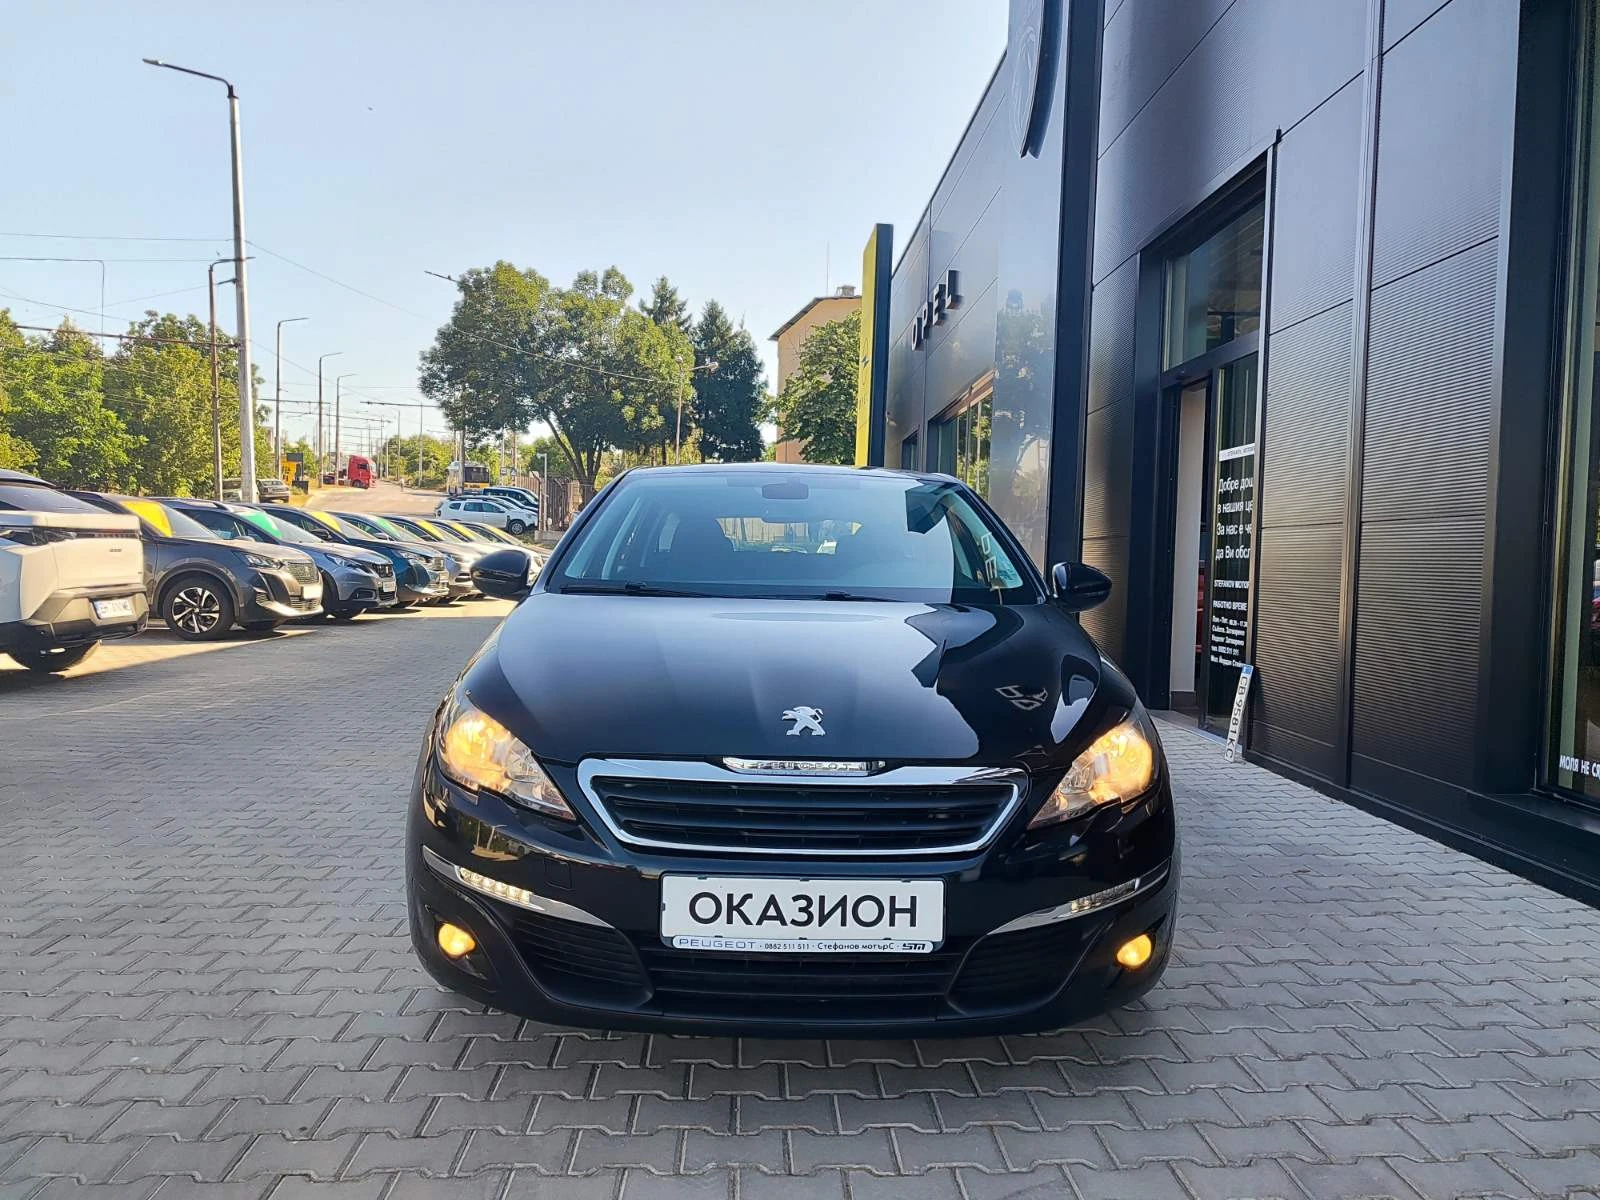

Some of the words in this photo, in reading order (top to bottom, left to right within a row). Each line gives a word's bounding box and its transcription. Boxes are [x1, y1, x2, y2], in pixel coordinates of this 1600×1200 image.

[1218, 477, 1239, 493] Добре
[1217, 503, 1221, 514] в
[1222, 501, 1243, 513] нашия
[1216, 522, 1224, 535] За
[1226, 524, 1238, 535] нас
[1239, 524, 1244, 534] е
[1215, 548, 1224, 560] да
[1225, 546, 1234, 558] Ви
[1559, 754, 1579, 773] МОЛЯ
[1581, 759, 1589, 775] НЕ
[688, 891, 918, 928] ОКАЗИОН
[678, 938, 757, 949] PEUGEOT
[817, 942, 859, 951] Стефанов
